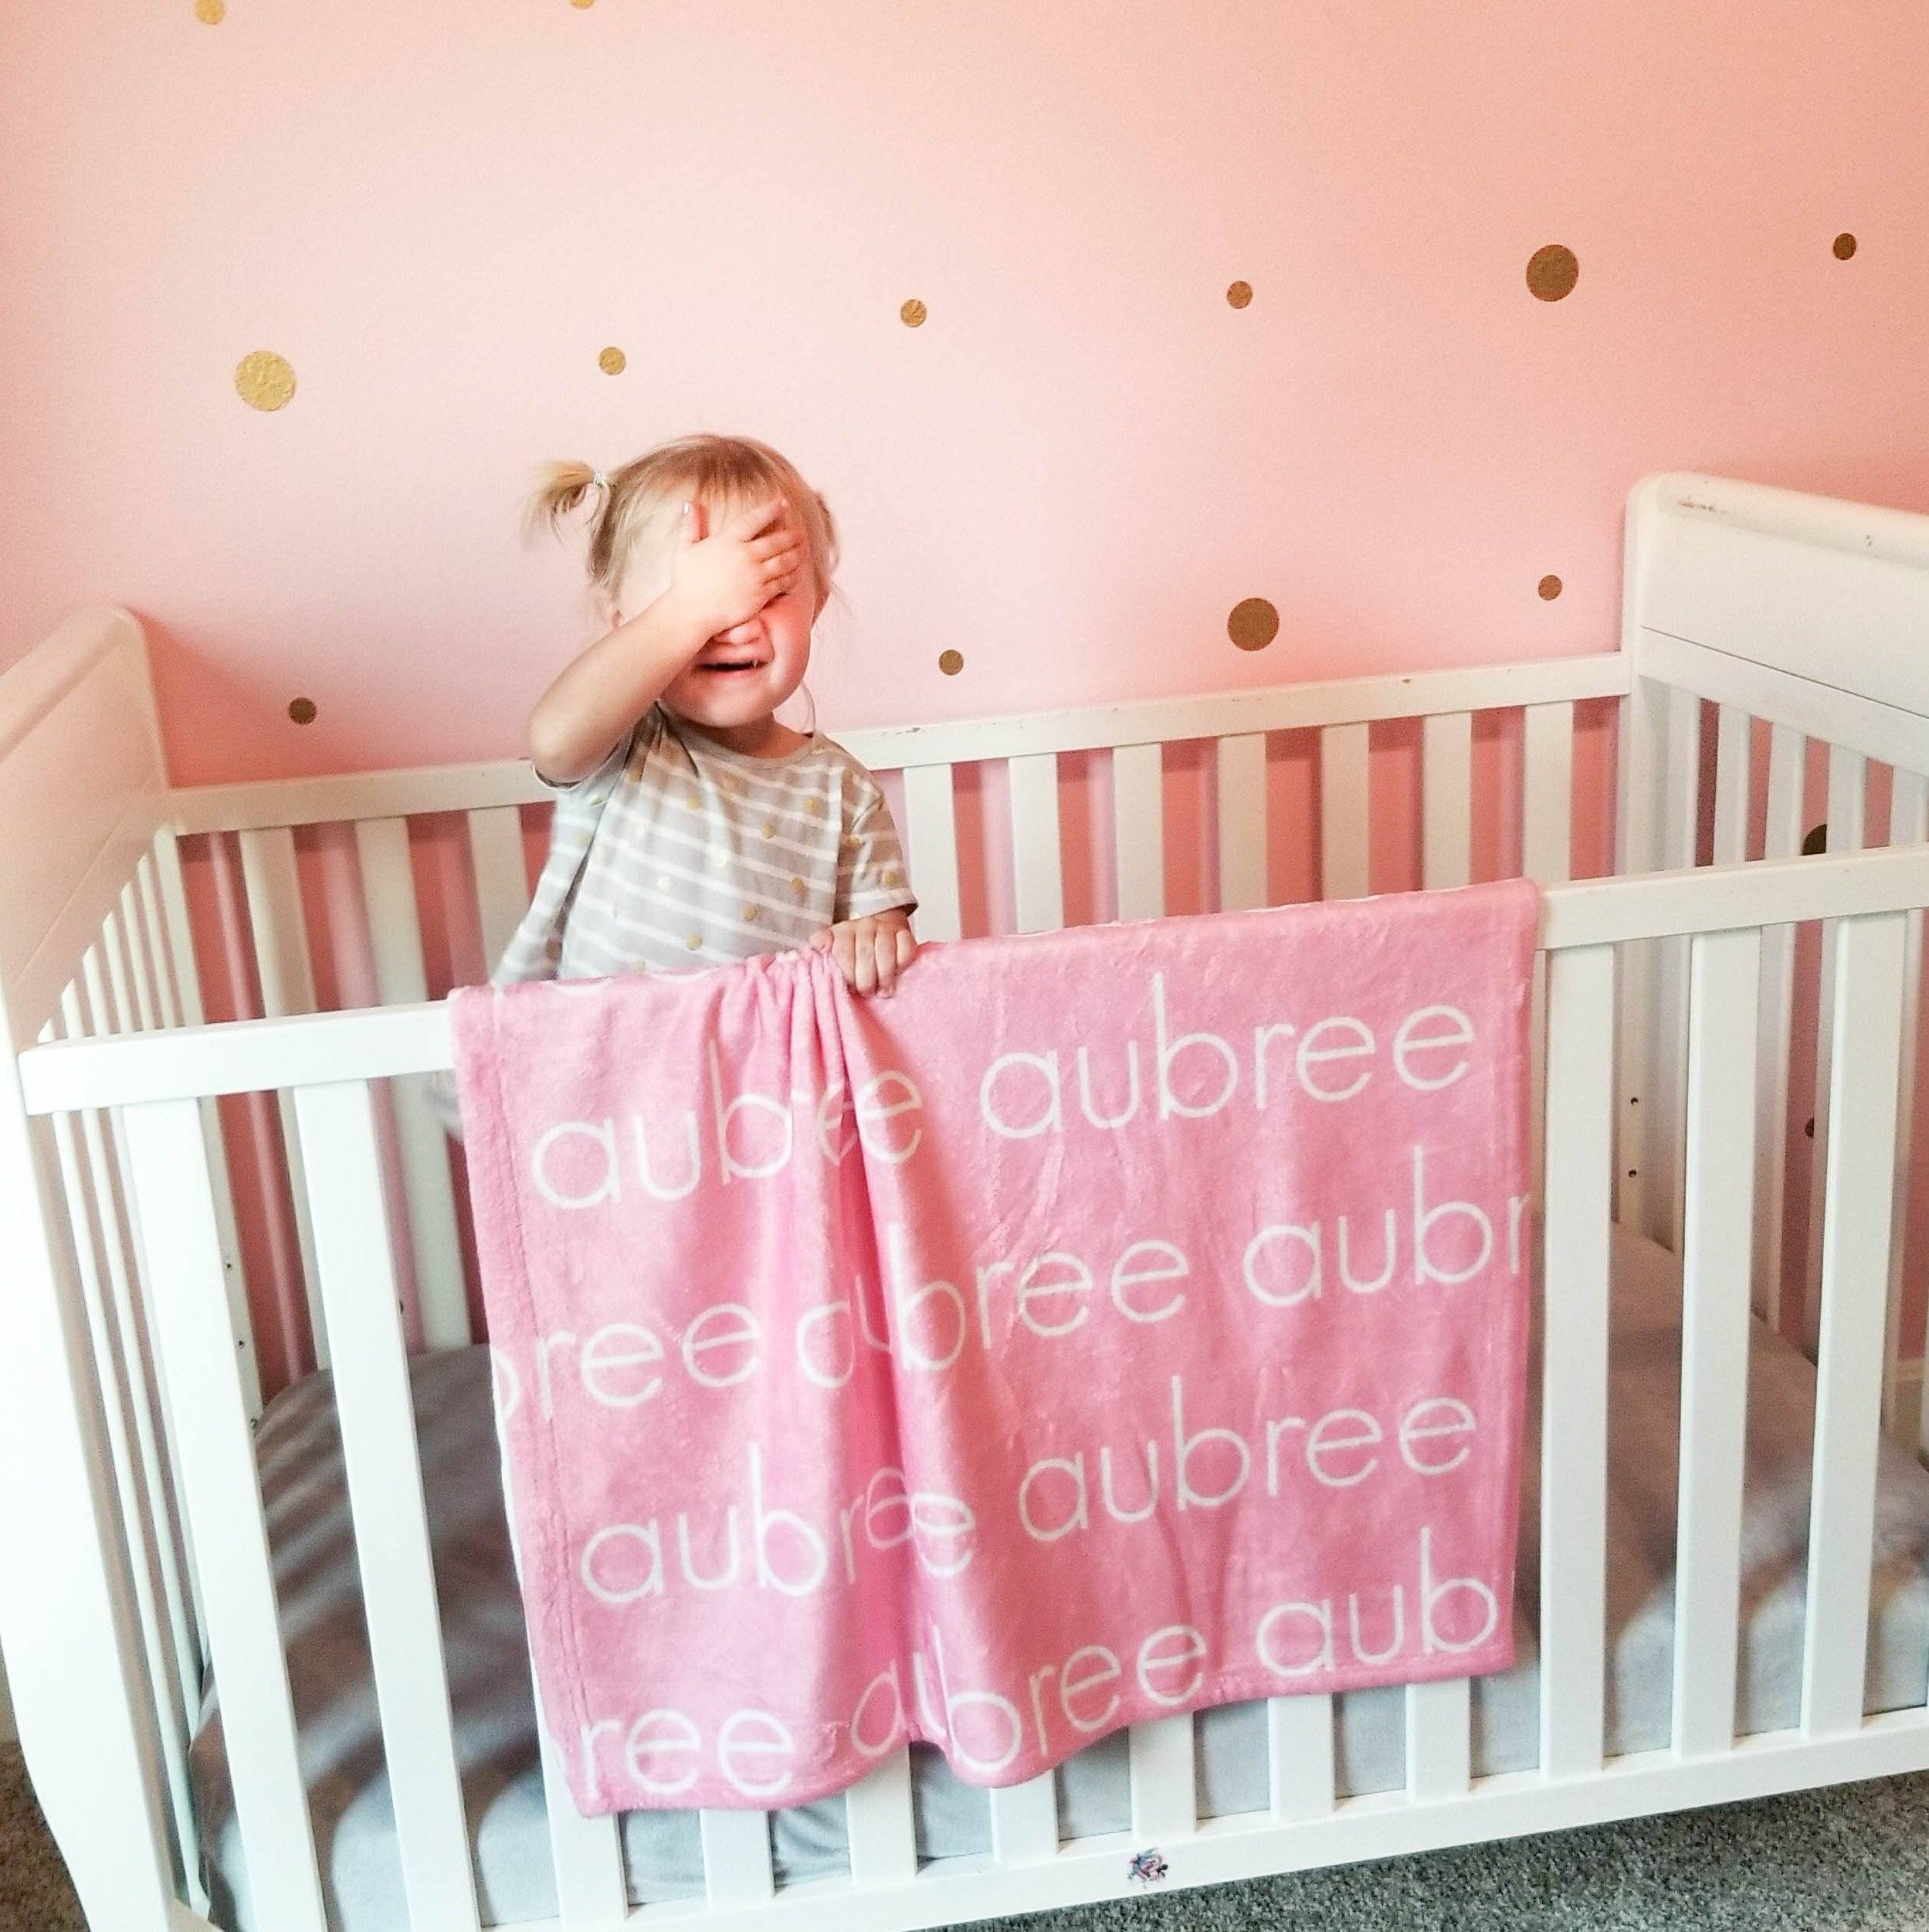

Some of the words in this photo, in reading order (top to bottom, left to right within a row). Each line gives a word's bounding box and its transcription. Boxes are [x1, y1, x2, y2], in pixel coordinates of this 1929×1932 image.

[531, 1039, 922, 1210] aubee
[980, 973, 1473, 1139] aubree
[1242, 1145, 1533, 1307] aubr
[580, 1441, 976, 1603] aubree
[1019, 1375, 1476, 1541] aubree
[1256, 1527, 1498, 1677] aub
